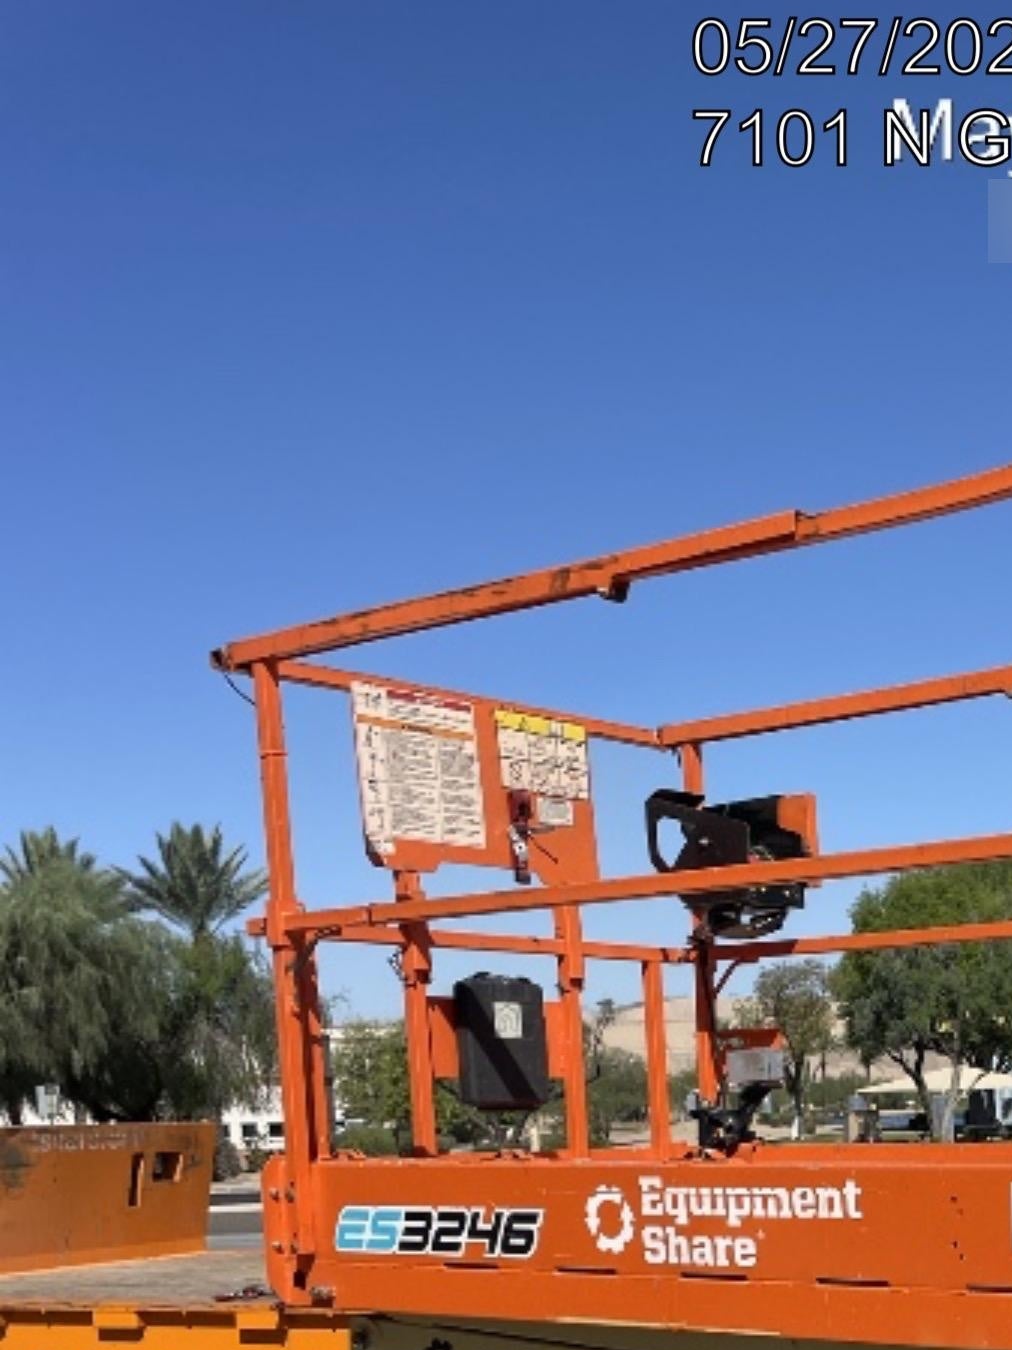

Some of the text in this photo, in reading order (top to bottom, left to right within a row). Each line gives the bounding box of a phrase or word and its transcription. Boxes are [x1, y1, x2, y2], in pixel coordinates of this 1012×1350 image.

[638, 1176, 862, 1227] Equipment
[335, 1206, 545, 1257] ES3246
[641, 1226, 757, 1267] Share
